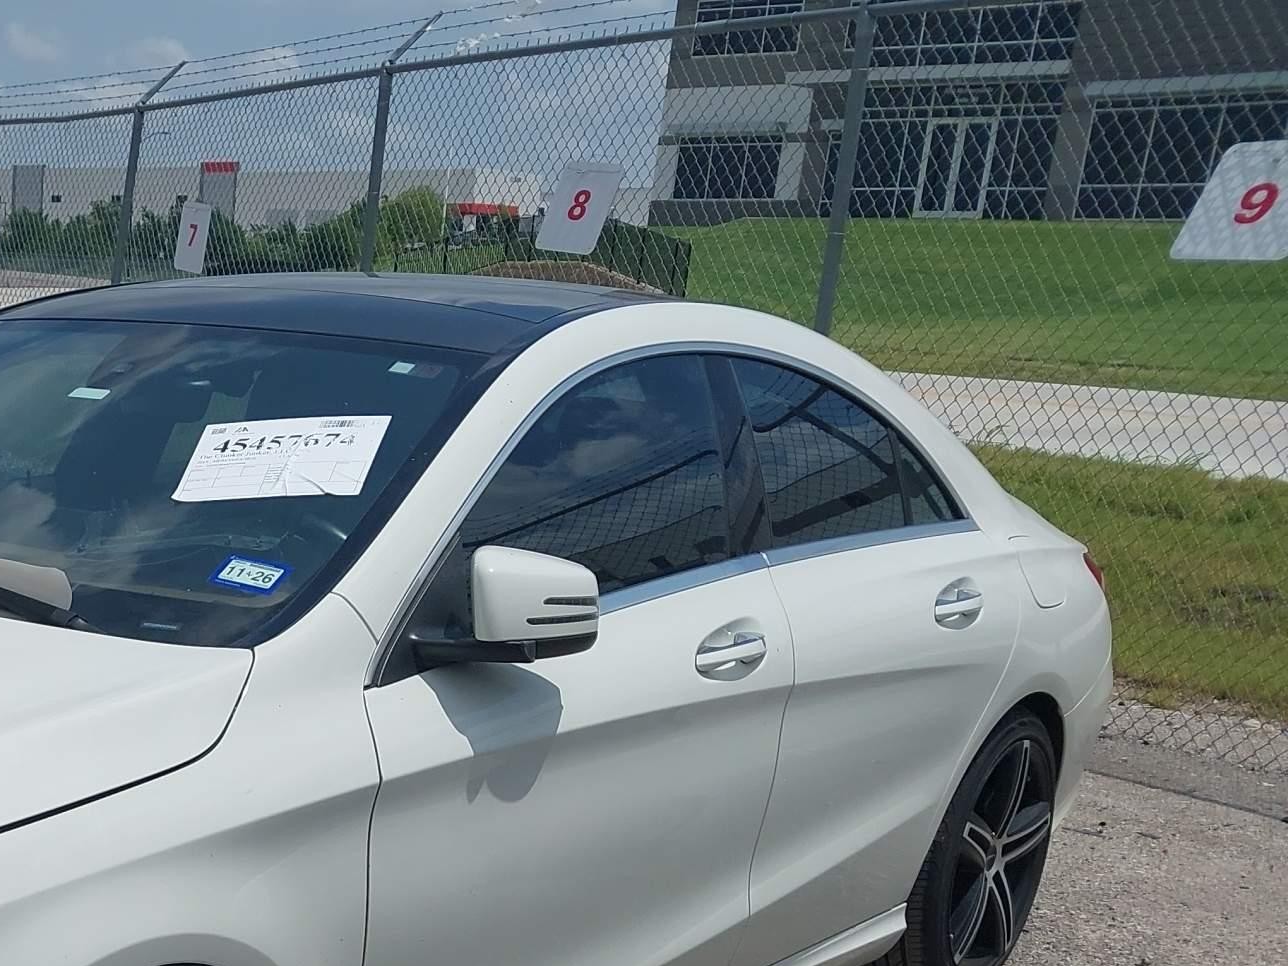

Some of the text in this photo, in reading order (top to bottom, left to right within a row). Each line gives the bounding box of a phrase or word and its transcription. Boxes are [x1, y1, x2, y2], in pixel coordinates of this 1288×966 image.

[567, 189, 592, 221] 8
[1233, 182, 1279, 225] 9
[188, 223, 198, 247] 7
[213, 432, 356, 454] 45457674
